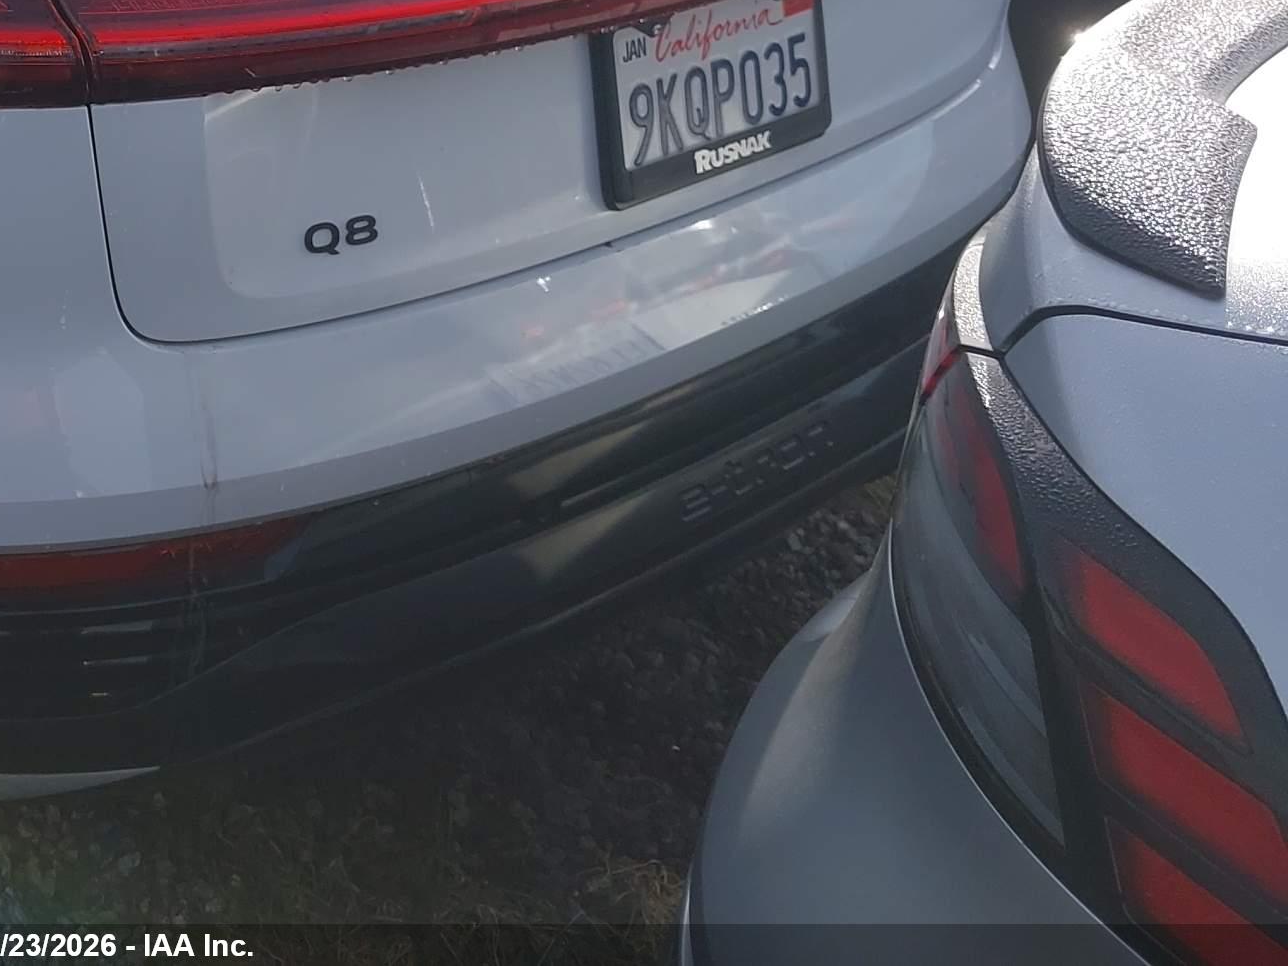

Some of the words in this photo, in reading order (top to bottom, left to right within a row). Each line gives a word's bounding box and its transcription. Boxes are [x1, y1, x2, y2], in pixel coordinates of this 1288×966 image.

[622, 37, 647, 62] JAN
[654, 8, 782, 63] California
[629, 32, 811, 166] 9KQP035
[694, 130, 771, 174] RUSNAK
[304, 215, 378, 255] Q8
